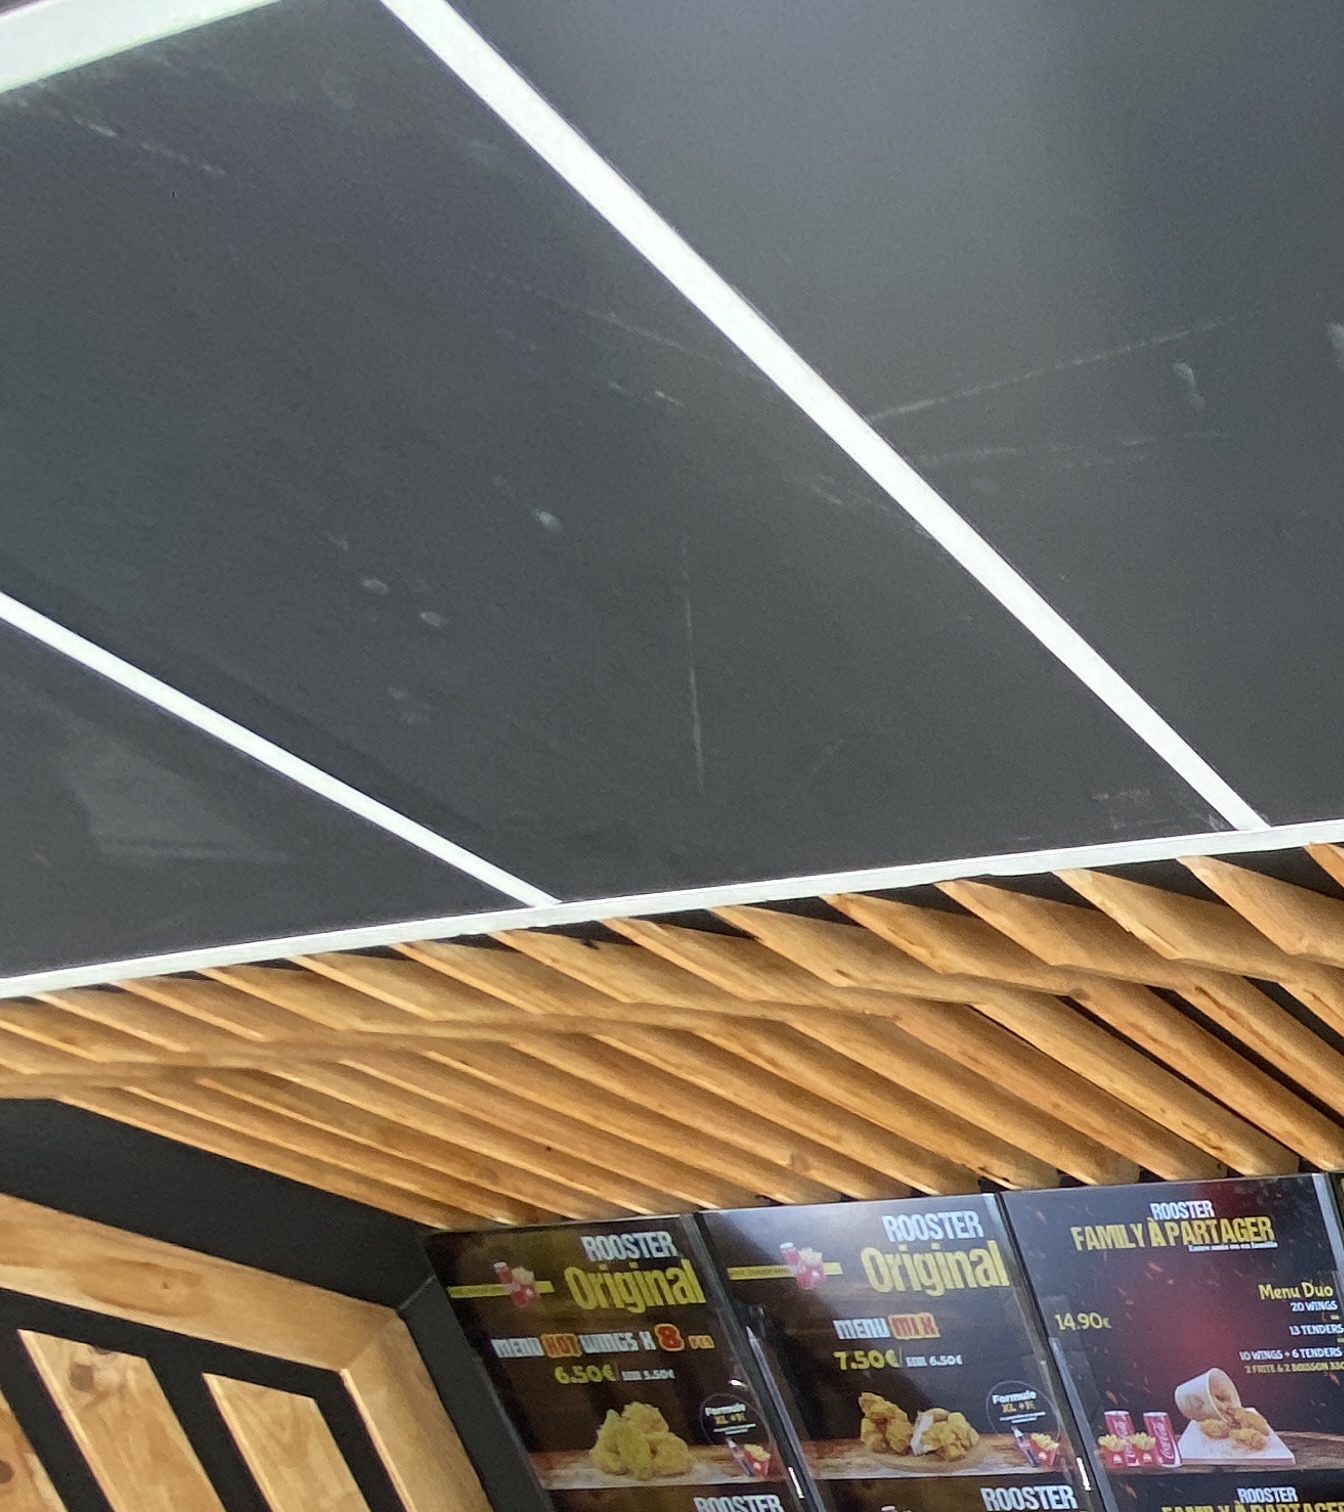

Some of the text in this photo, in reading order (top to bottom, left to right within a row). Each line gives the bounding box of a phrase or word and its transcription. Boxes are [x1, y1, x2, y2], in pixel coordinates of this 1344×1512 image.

[1150, 1200, 1214, 1220] ROOSTER
[881, 1210, 984, 1243] ROOSTER
[1070, 1216, 1275, 1250] FAMILY À PARTAGER
[580, 1231, 678, 1262] ROOSTER
[861, 1240, 1010, 1296] Original
[564, 1259, 706, 1313] Original
[1258, 1282, 1333, 1300] Menu Duo
[1305, 1301, 1338, 1311] WINGS
[833, 1318, 891, 1340] MENU
[1055, 1313, 1111, 1330] 14.90€
[1301, 1324, 1344, 1335] TENDERS
[654, 1324, 684, 1351] 8
[834, 1350, 898, 1370] 7.50€
[1300, 1347, 1342, 1358] TENDERS
[555, 1364, 616, 1384] 6.50€
[981, 1485, 1078, 1511] ROOSTER
[1237, 1486, 1298, 1504] ROOSTER
